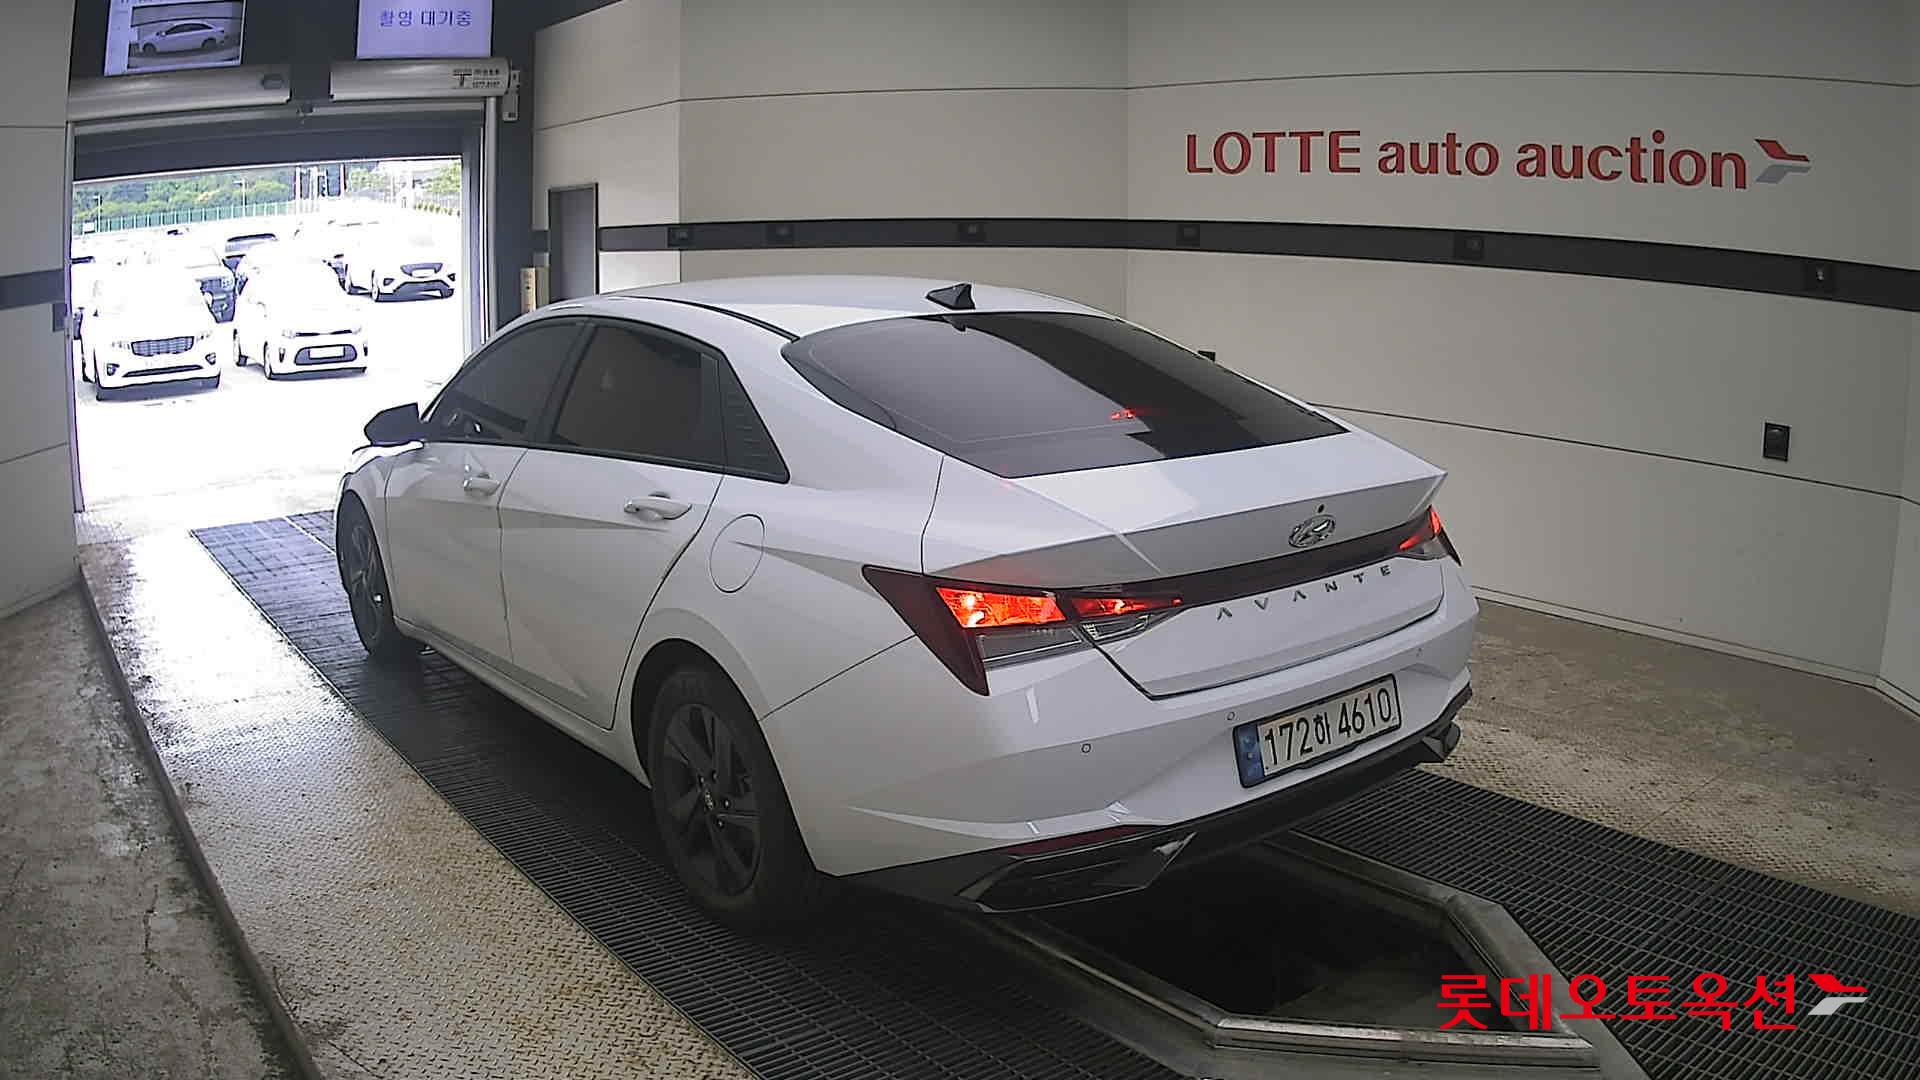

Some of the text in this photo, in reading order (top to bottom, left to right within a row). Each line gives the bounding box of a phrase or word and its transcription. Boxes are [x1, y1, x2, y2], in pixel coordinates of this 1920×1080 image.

[421, 10, 472, 26] 대기중
[1187, 130, 1747, 189] LOTTE auto auction
[1217, 564, 1392, 620] AVANTE
[1264, 713, 1332, 765] 172하
[1338, 687, 1392, 739] 4610
